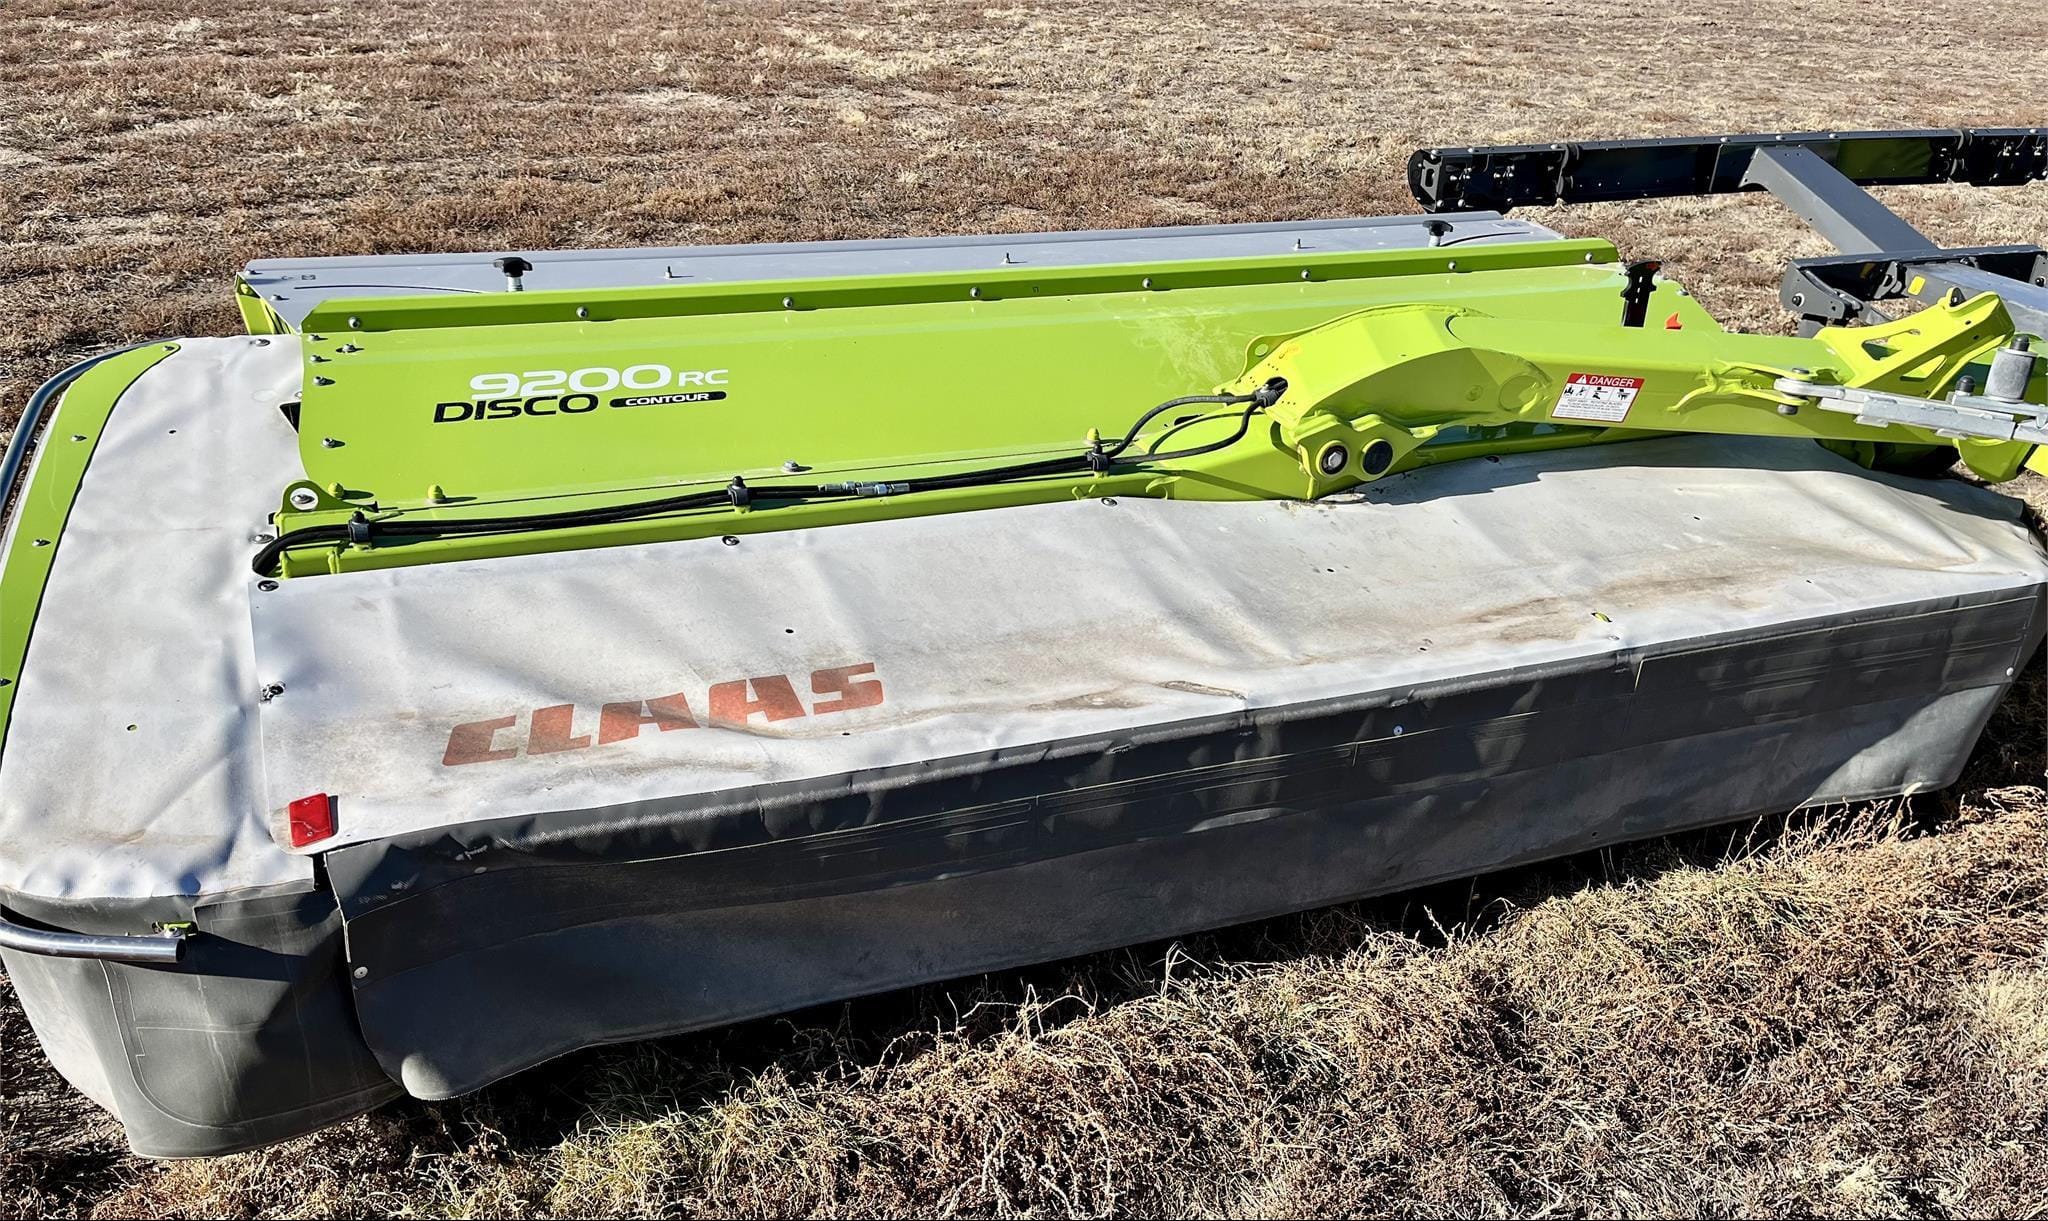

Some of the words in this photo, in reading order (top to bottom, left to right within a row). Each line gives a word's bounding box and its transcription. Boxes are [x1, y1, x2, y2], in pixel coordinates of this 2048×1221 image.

[469, 364, 672, 401] 9200
[678, 369, 729, 387] RC
[1589, 376, 1634, 387] DANGER
[433, 393, 599, 423] DISCO
[625, 392, 710, 407] CONTOUR
[442, 662, 884, 766] CLAAS
